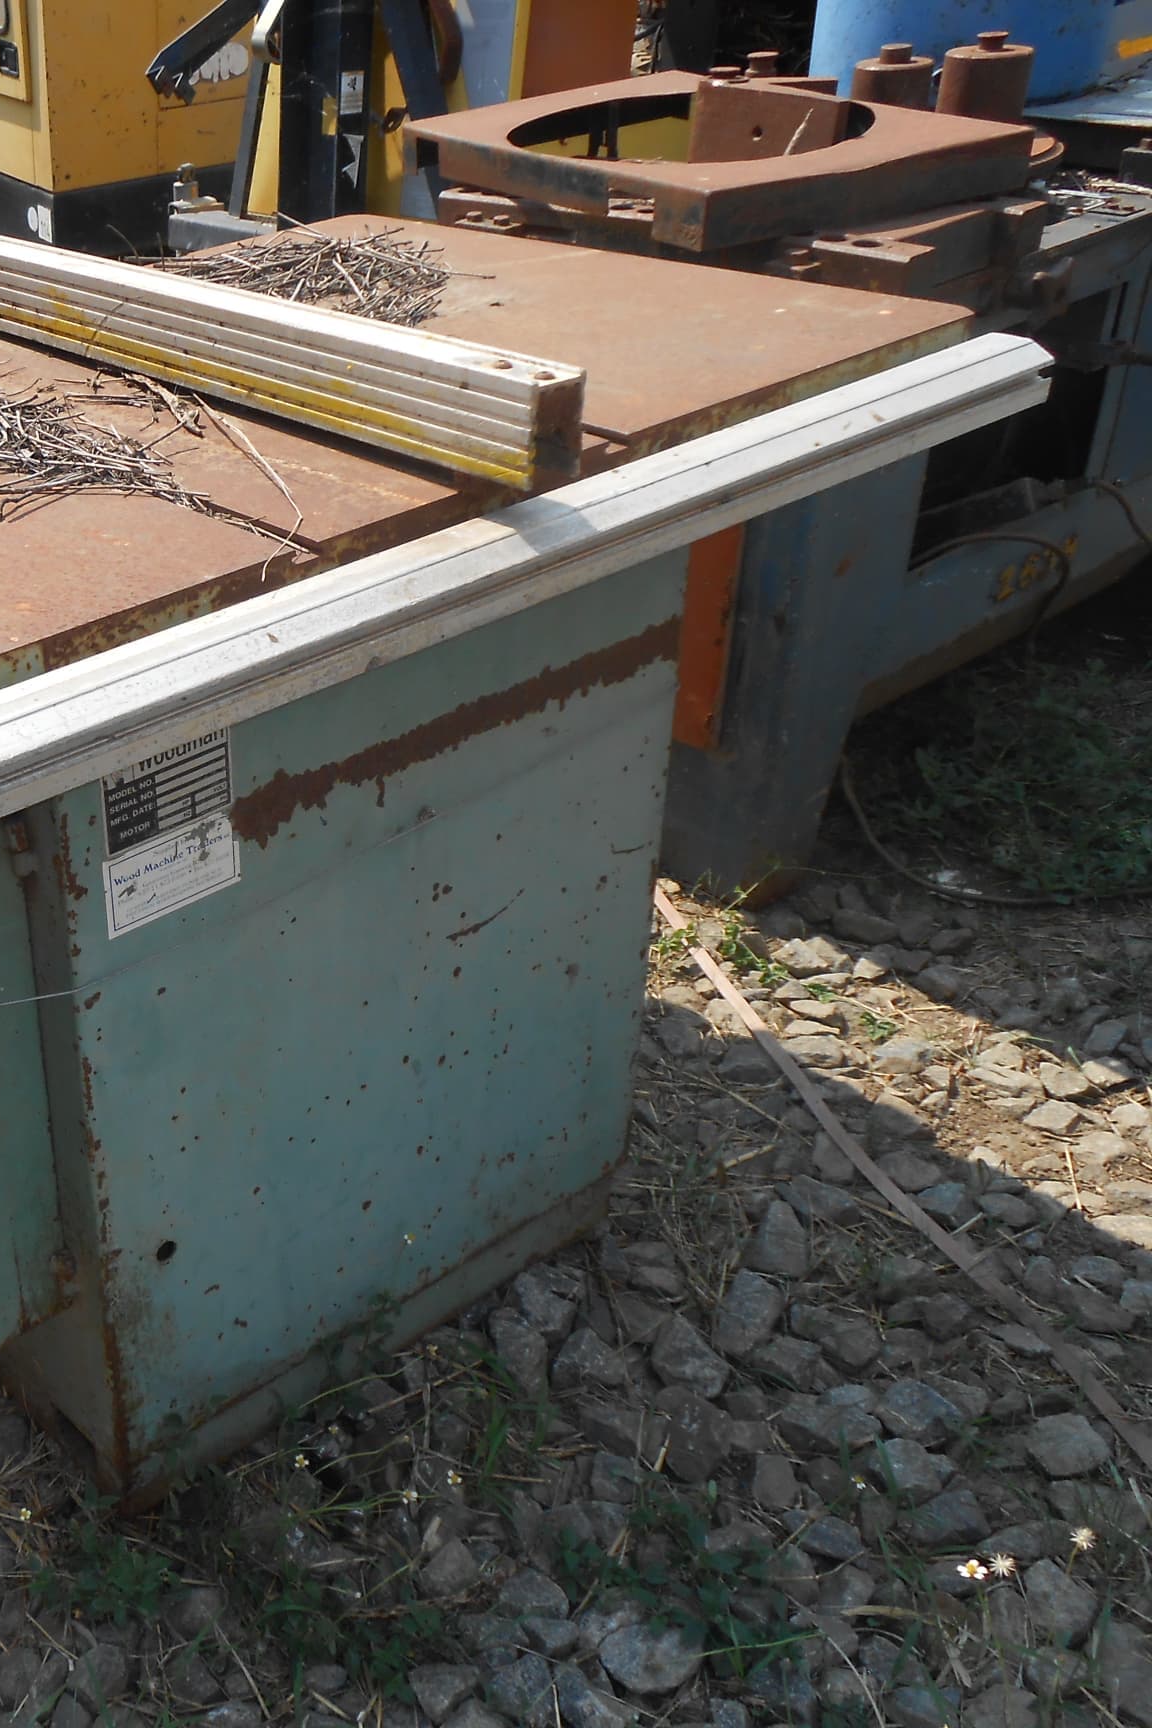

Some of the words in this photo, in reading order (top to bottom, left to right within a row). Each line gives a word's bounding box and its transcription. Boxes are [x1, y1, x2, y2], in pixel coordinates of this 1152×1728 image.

[108, 785, 137, 803] MODEL
[139, 778, 155, 790] NO.
[109, 798, 139, 815] SERIAL
[110, 812, 130, 827] MFG.
[120, 821, 151, 840] MOTOR
[113, 869, 141, 886] Wood
[143, 851, 184, 875] Machine
